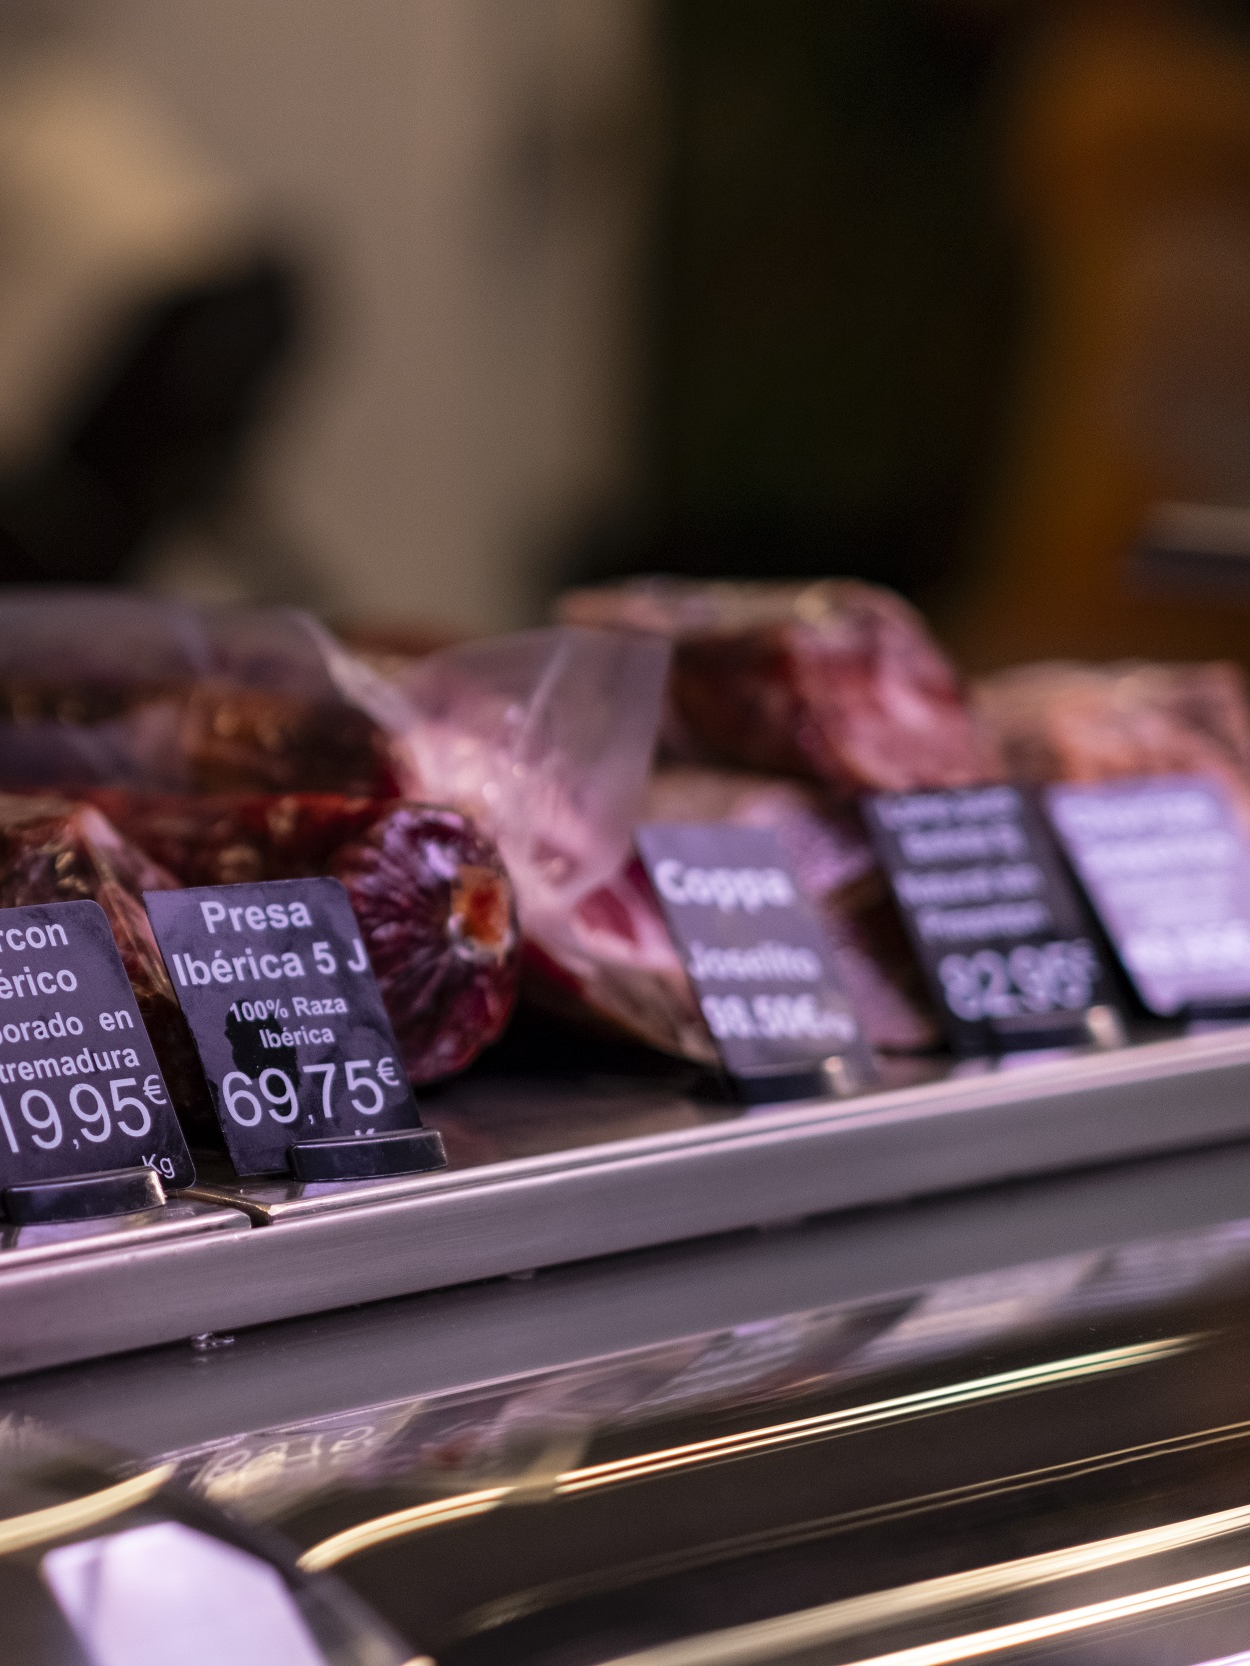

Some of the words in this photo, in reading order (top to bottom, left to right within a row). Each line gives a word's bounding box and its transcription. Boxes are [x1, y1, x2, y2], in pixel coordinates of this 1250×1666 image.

[654, 858, 796, 914] Coppa
[200, 900, 313, 934] Presa
[172, 947, 305, 987] Ibérica
[312, 941, 337, 975] 5
[347, 938, 368, 973] J
[99, 1009, 134, 1031] en
[229, 998, 289, 1023] 100%
[292, 996, 348, 1017] Raza
[259, 1025, 335, 1049] Ibérica
[222, 1057, 399, 1127] 69,75€
[142, 1153, 175, 1179] Kg
